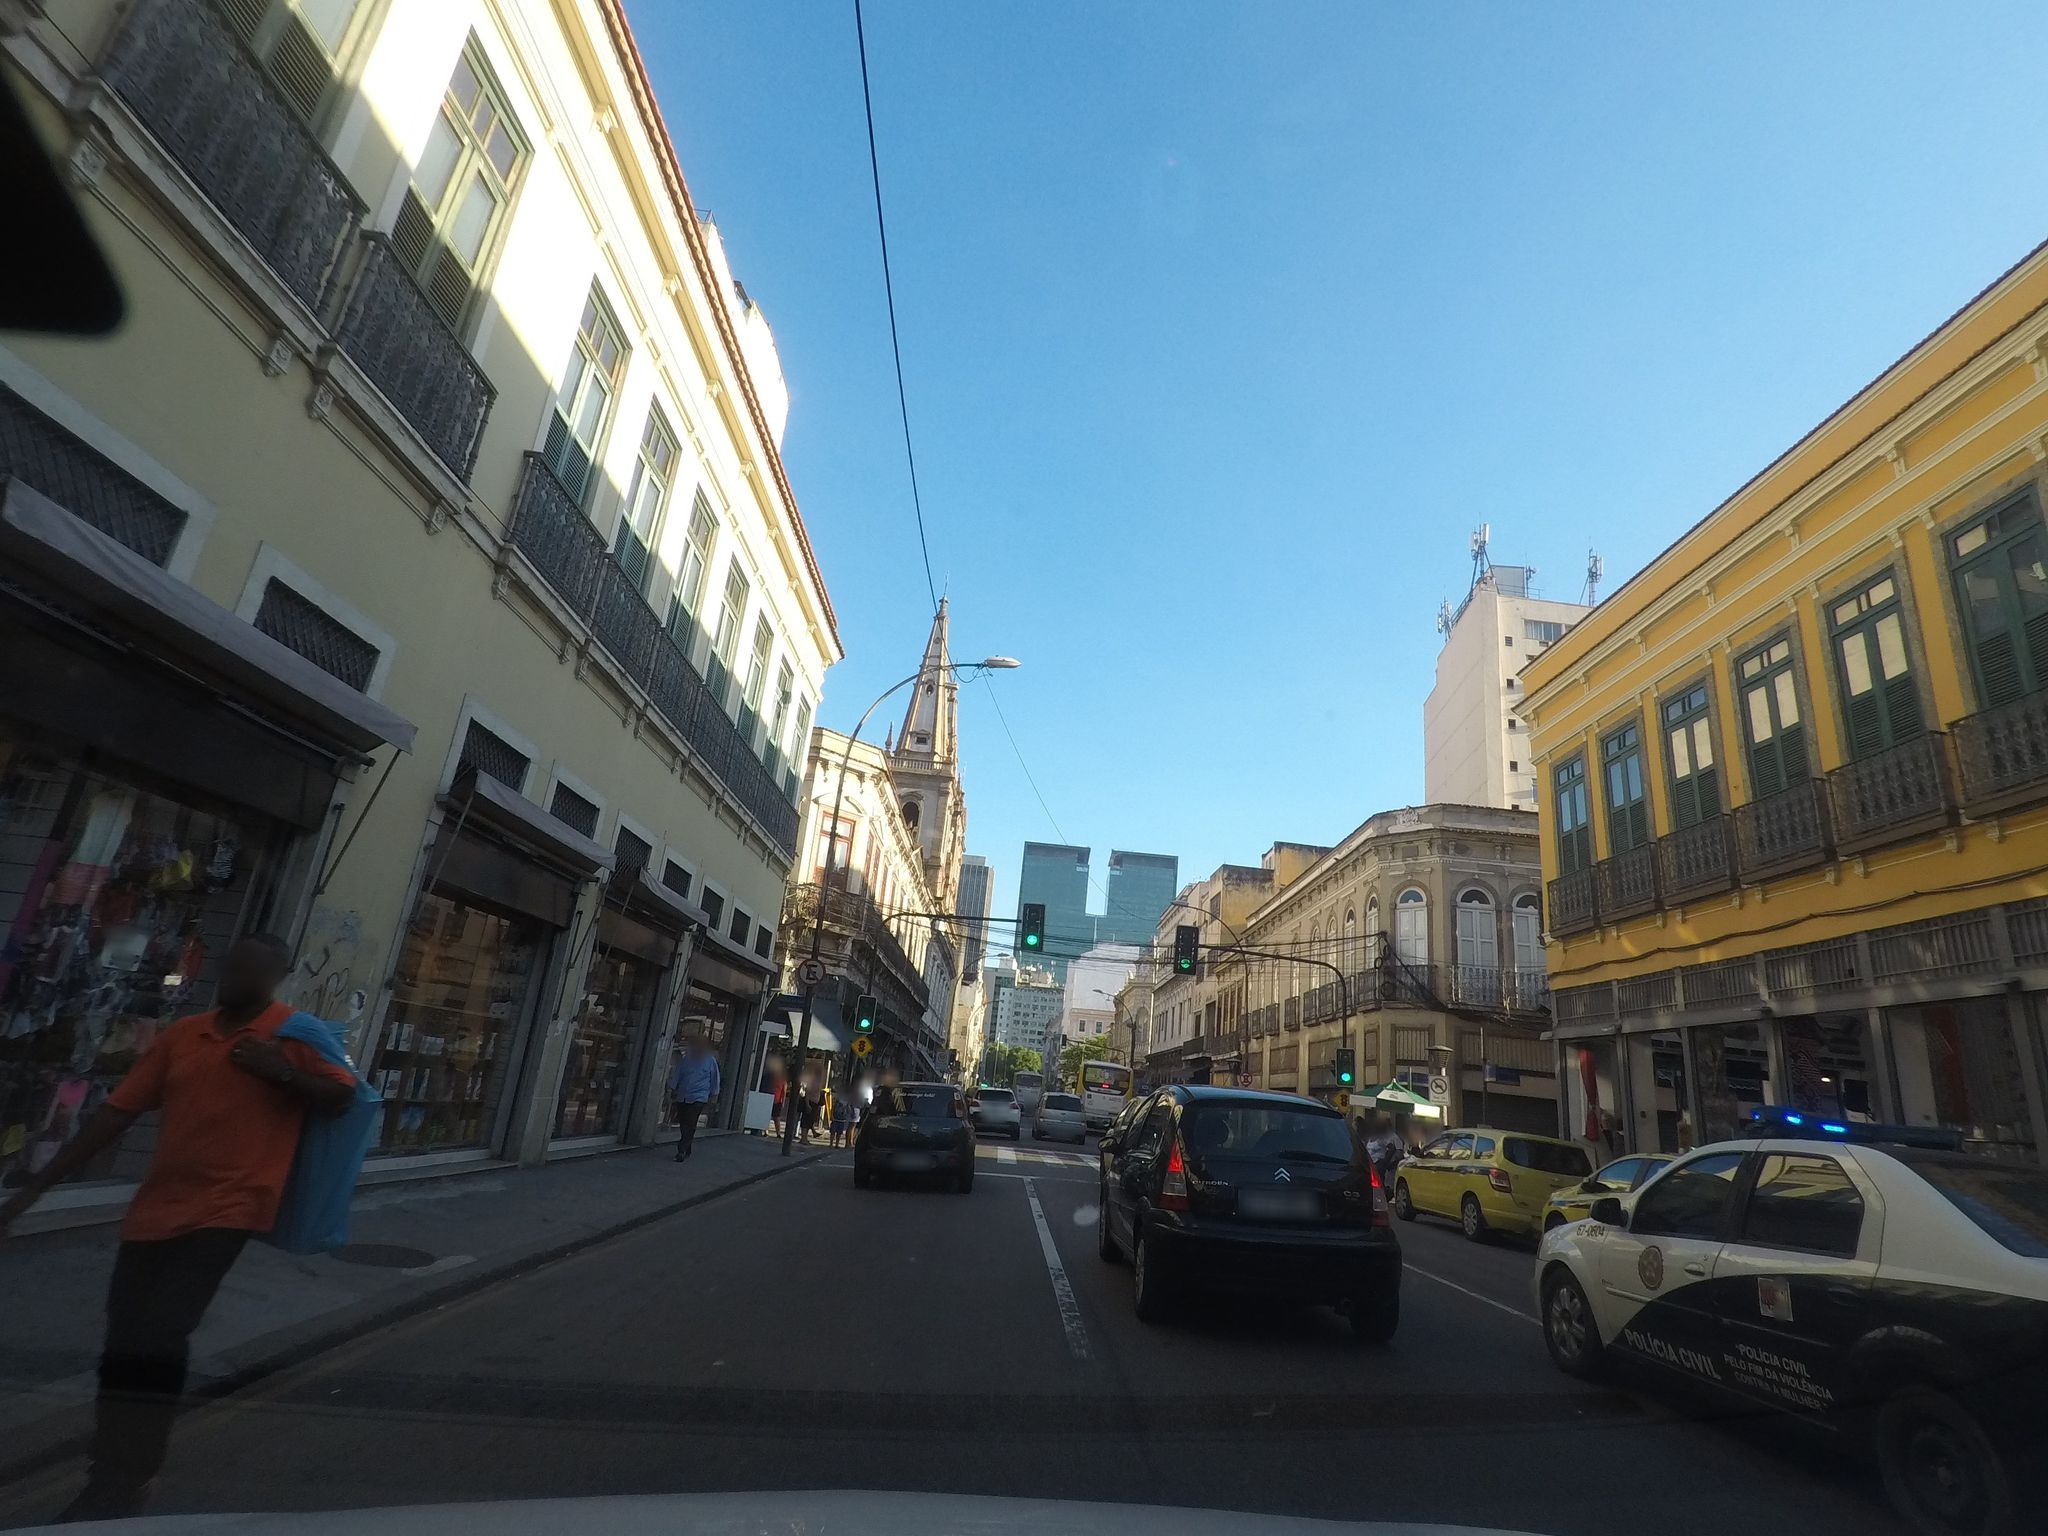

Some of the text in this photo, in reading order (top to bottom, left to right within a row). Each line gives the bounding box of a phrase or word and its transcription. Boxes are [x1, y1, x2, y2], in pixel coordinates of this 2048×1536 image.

[1343, 1190, 1361, 1198] C3
[1625, 1329, 1722, 1380] POLÍCIA CIVIL
[1724, 1353, 1746, 1370] PELO
[1766, 1367, 1779, 1381] DA
[1782, 1357, 1811, 1378] CIVIL
